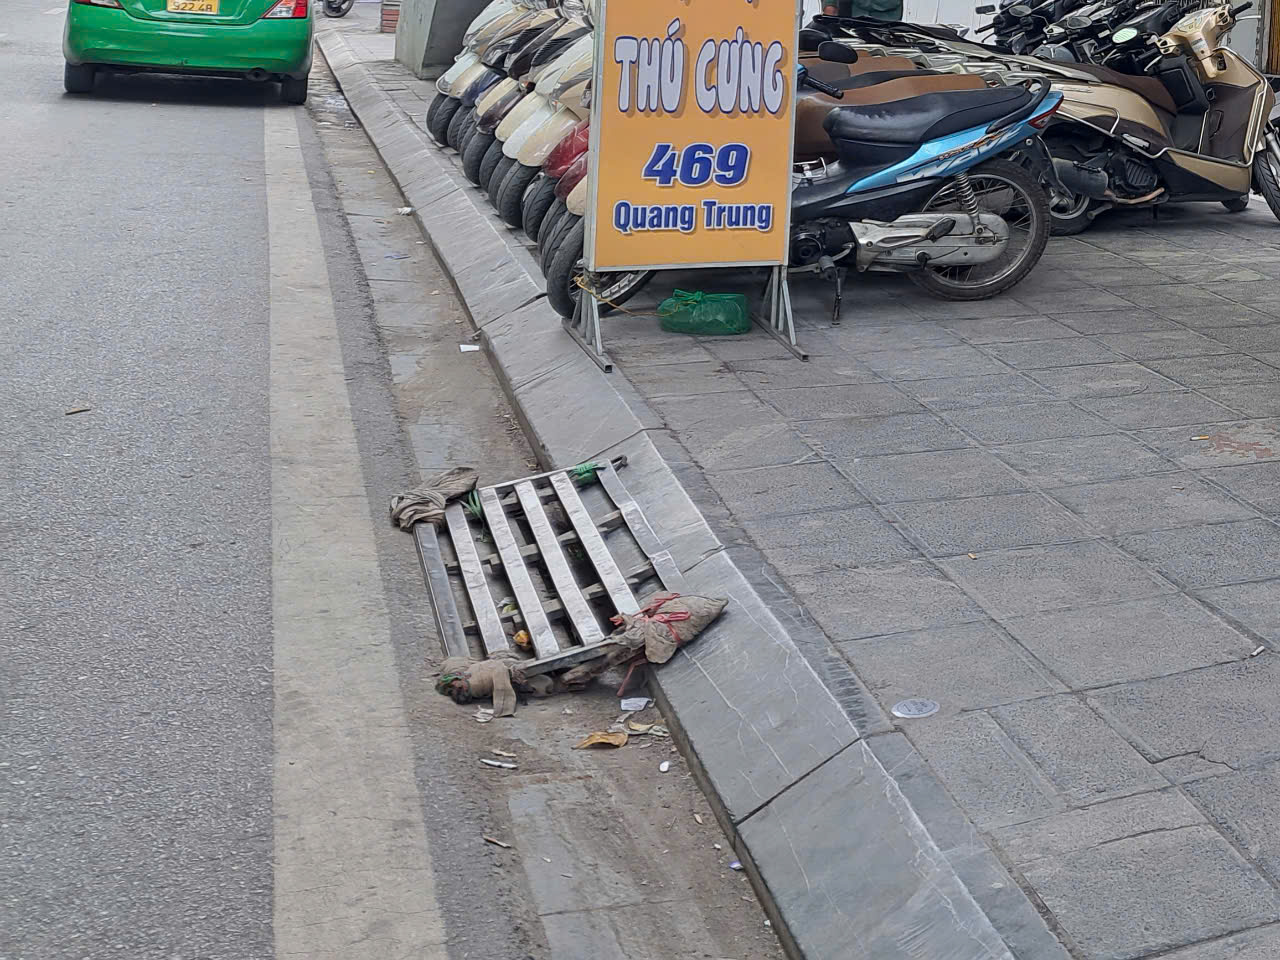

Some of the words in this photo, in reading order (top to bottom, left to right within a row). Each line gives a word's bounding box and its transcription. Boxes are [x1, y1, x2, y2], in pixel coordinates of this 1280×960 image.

[614, 17, 687, 114] THÚ
[695, 26, 784, 114] CƯNG
[642, 142, 752, 187] 469
[613, 201, 695, 233] Quang
[701, 199, 773, 232] Trung
